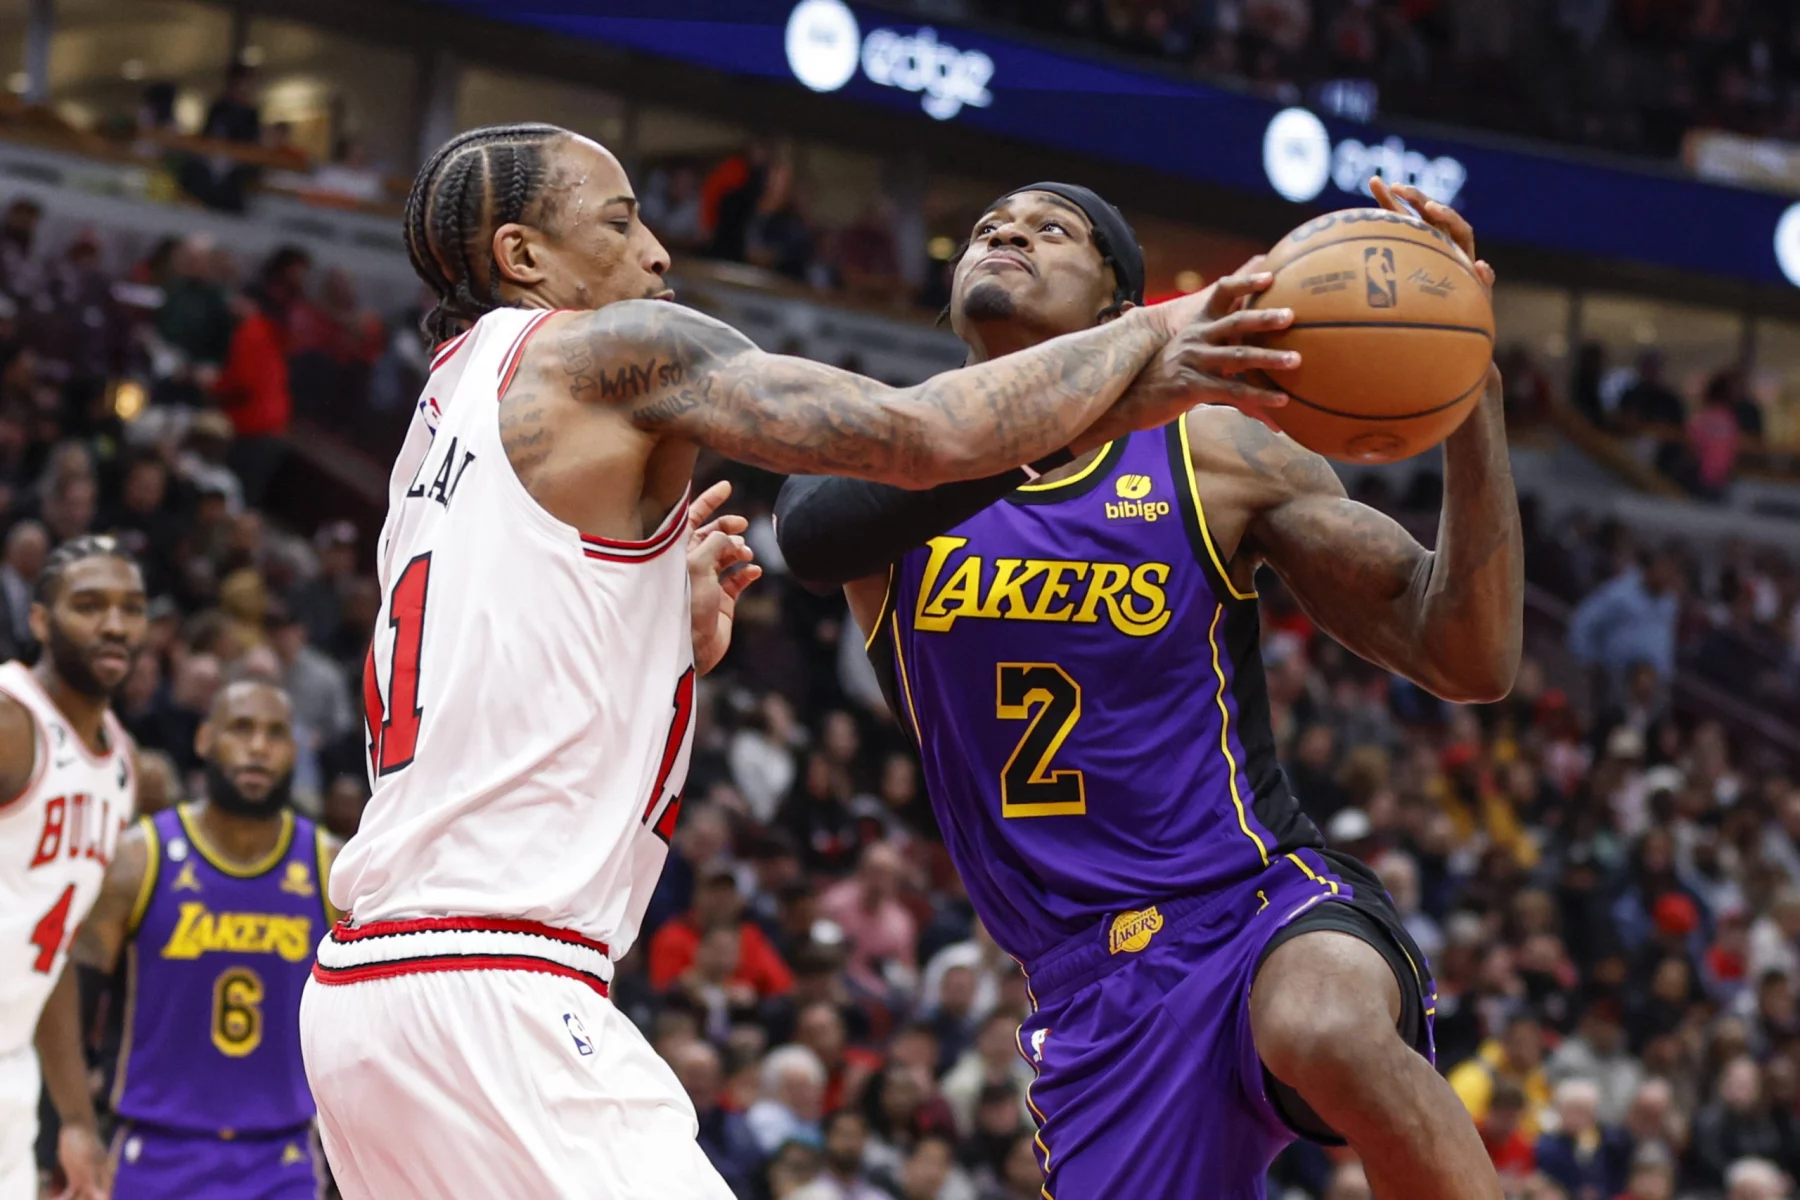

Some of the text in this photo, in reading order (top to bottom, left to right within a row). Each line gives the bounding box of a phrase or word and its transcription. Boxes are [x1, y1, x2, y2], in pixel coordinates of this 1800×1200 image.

[861, 27, 994, 120] edge
[600, 358, 656, 399] WHY
[1105, 500, 1170, 522] bibigo
[913, 535, 1172, 637] LAKERS
[996, 662, 1086, 818] 2
[30, 881, 80, 976] 4
[160, 901, 312, 962] LAKERS
[211, 966, 264, 1058] 6
